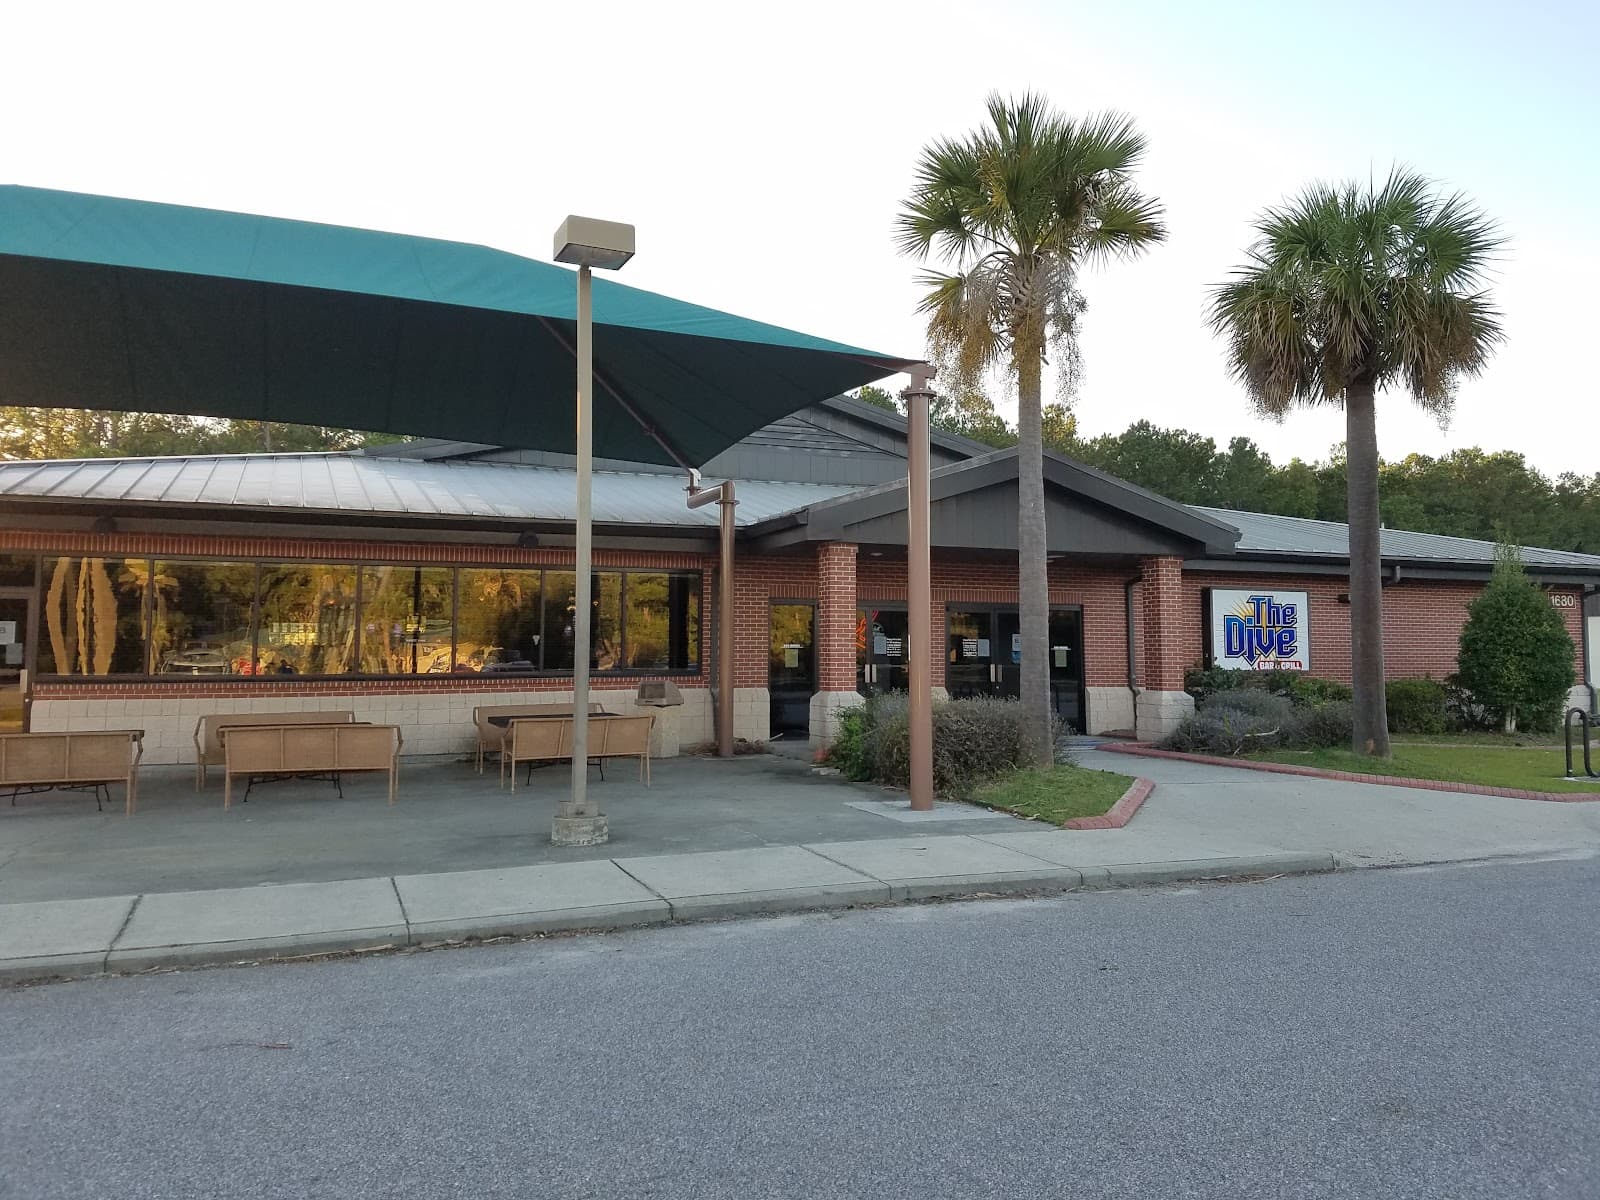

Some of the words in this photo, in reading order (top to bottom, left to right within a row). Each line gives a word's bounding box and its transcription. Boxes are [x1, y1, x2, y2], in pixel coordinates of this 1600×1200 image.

[1247, 595, 1297, 627] The
[1550, 595, 1573, 606] 1680
[1224, 615, 1297, 666] Dive
[1259, 661, 1275, 670] BAR
[1281, 661, 1301, 670] GRILL
